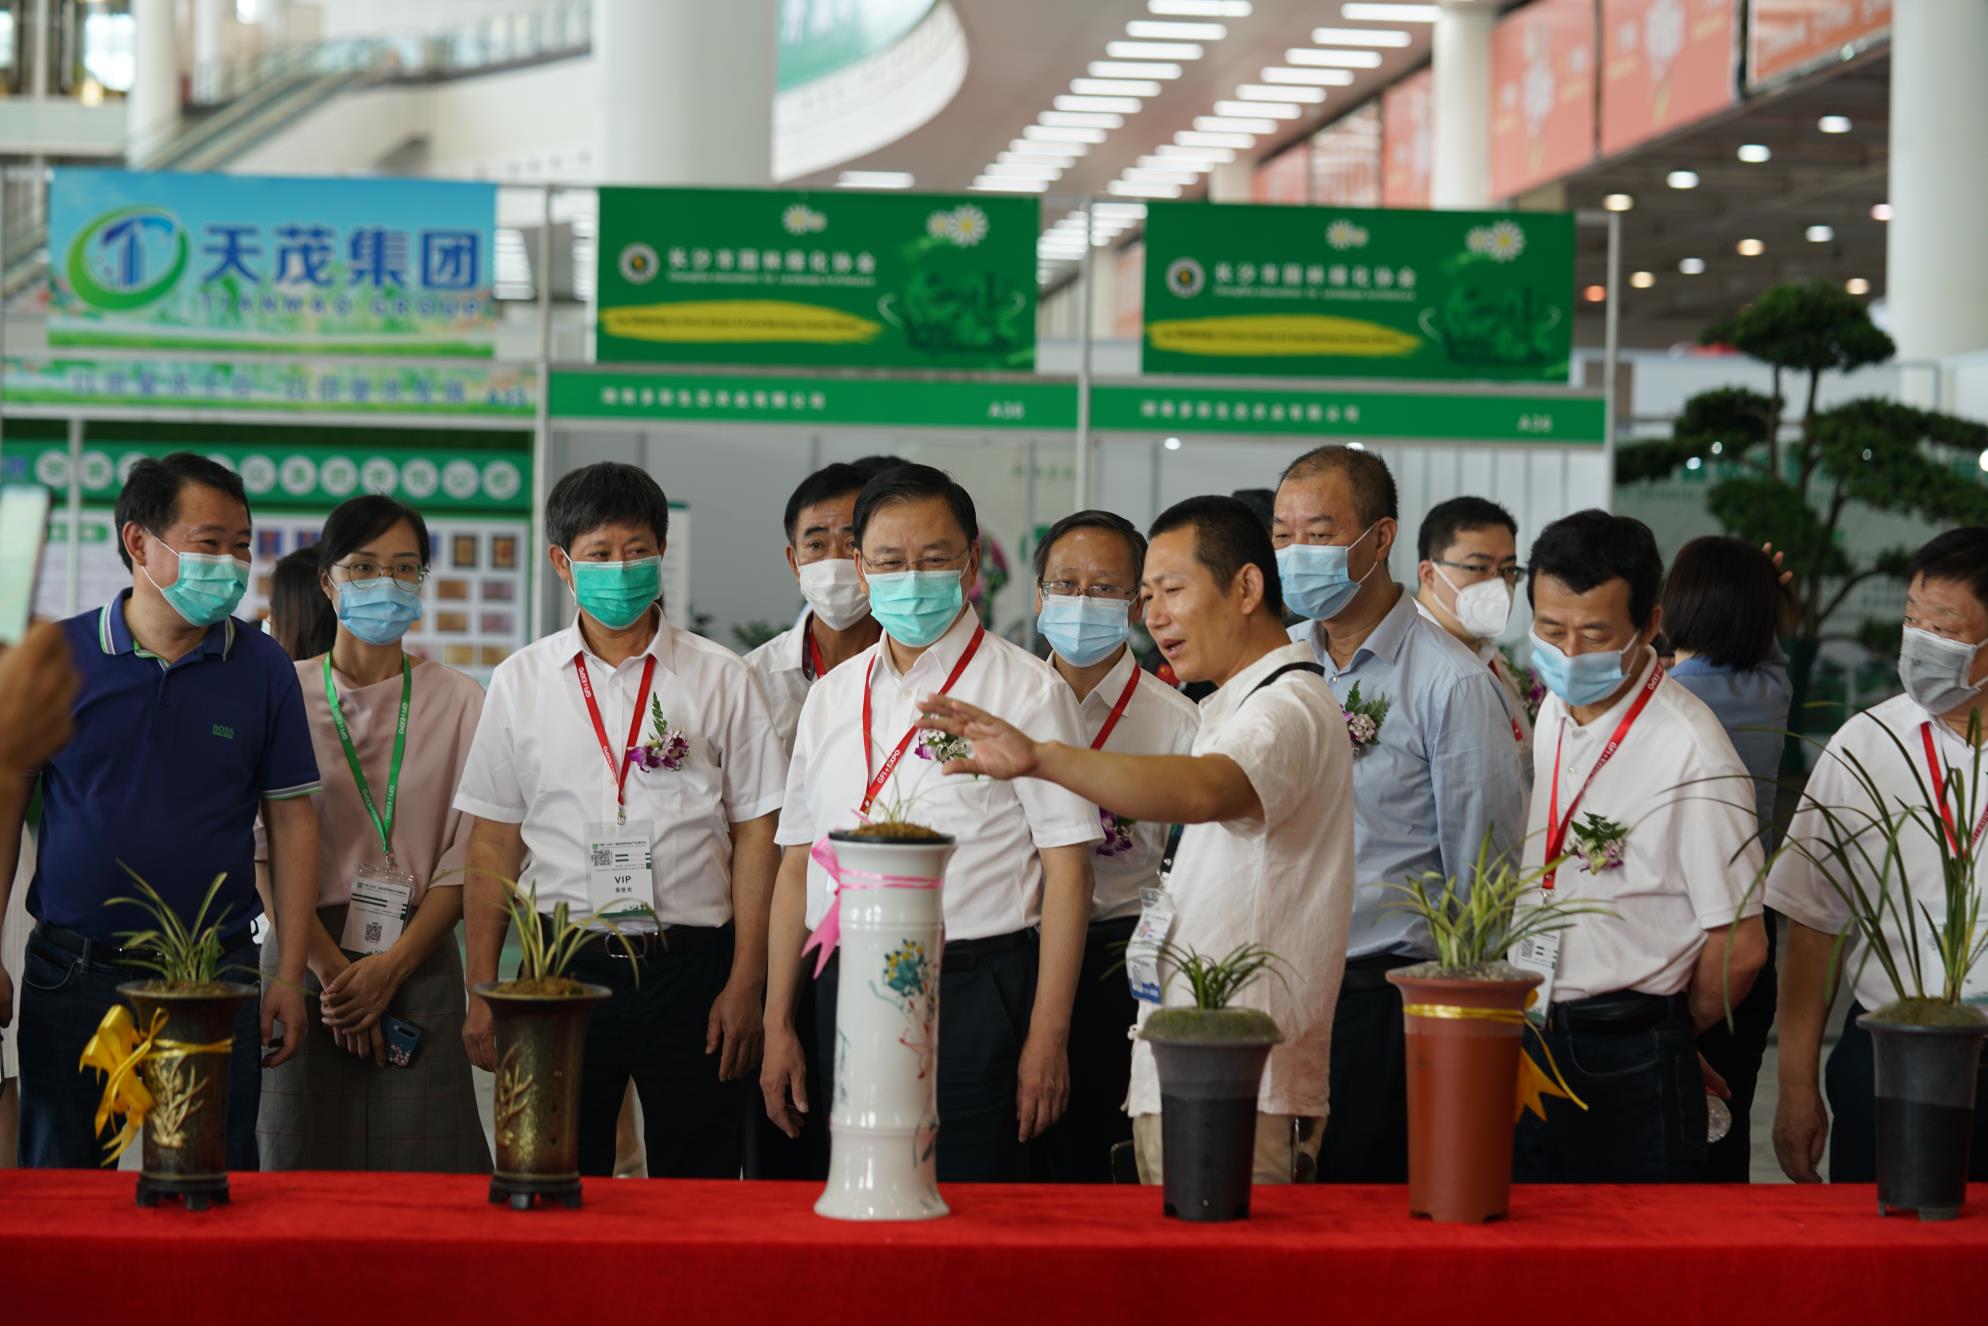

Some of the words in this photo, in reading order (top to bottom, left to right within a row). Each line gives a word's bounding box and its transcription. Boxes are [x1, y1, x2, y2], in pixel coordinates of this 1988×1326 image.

[203, 224, 483, 290] 天茂集团
[372, 298, 481, 318] GROUP
[614, 875, 632, 884] VIP
